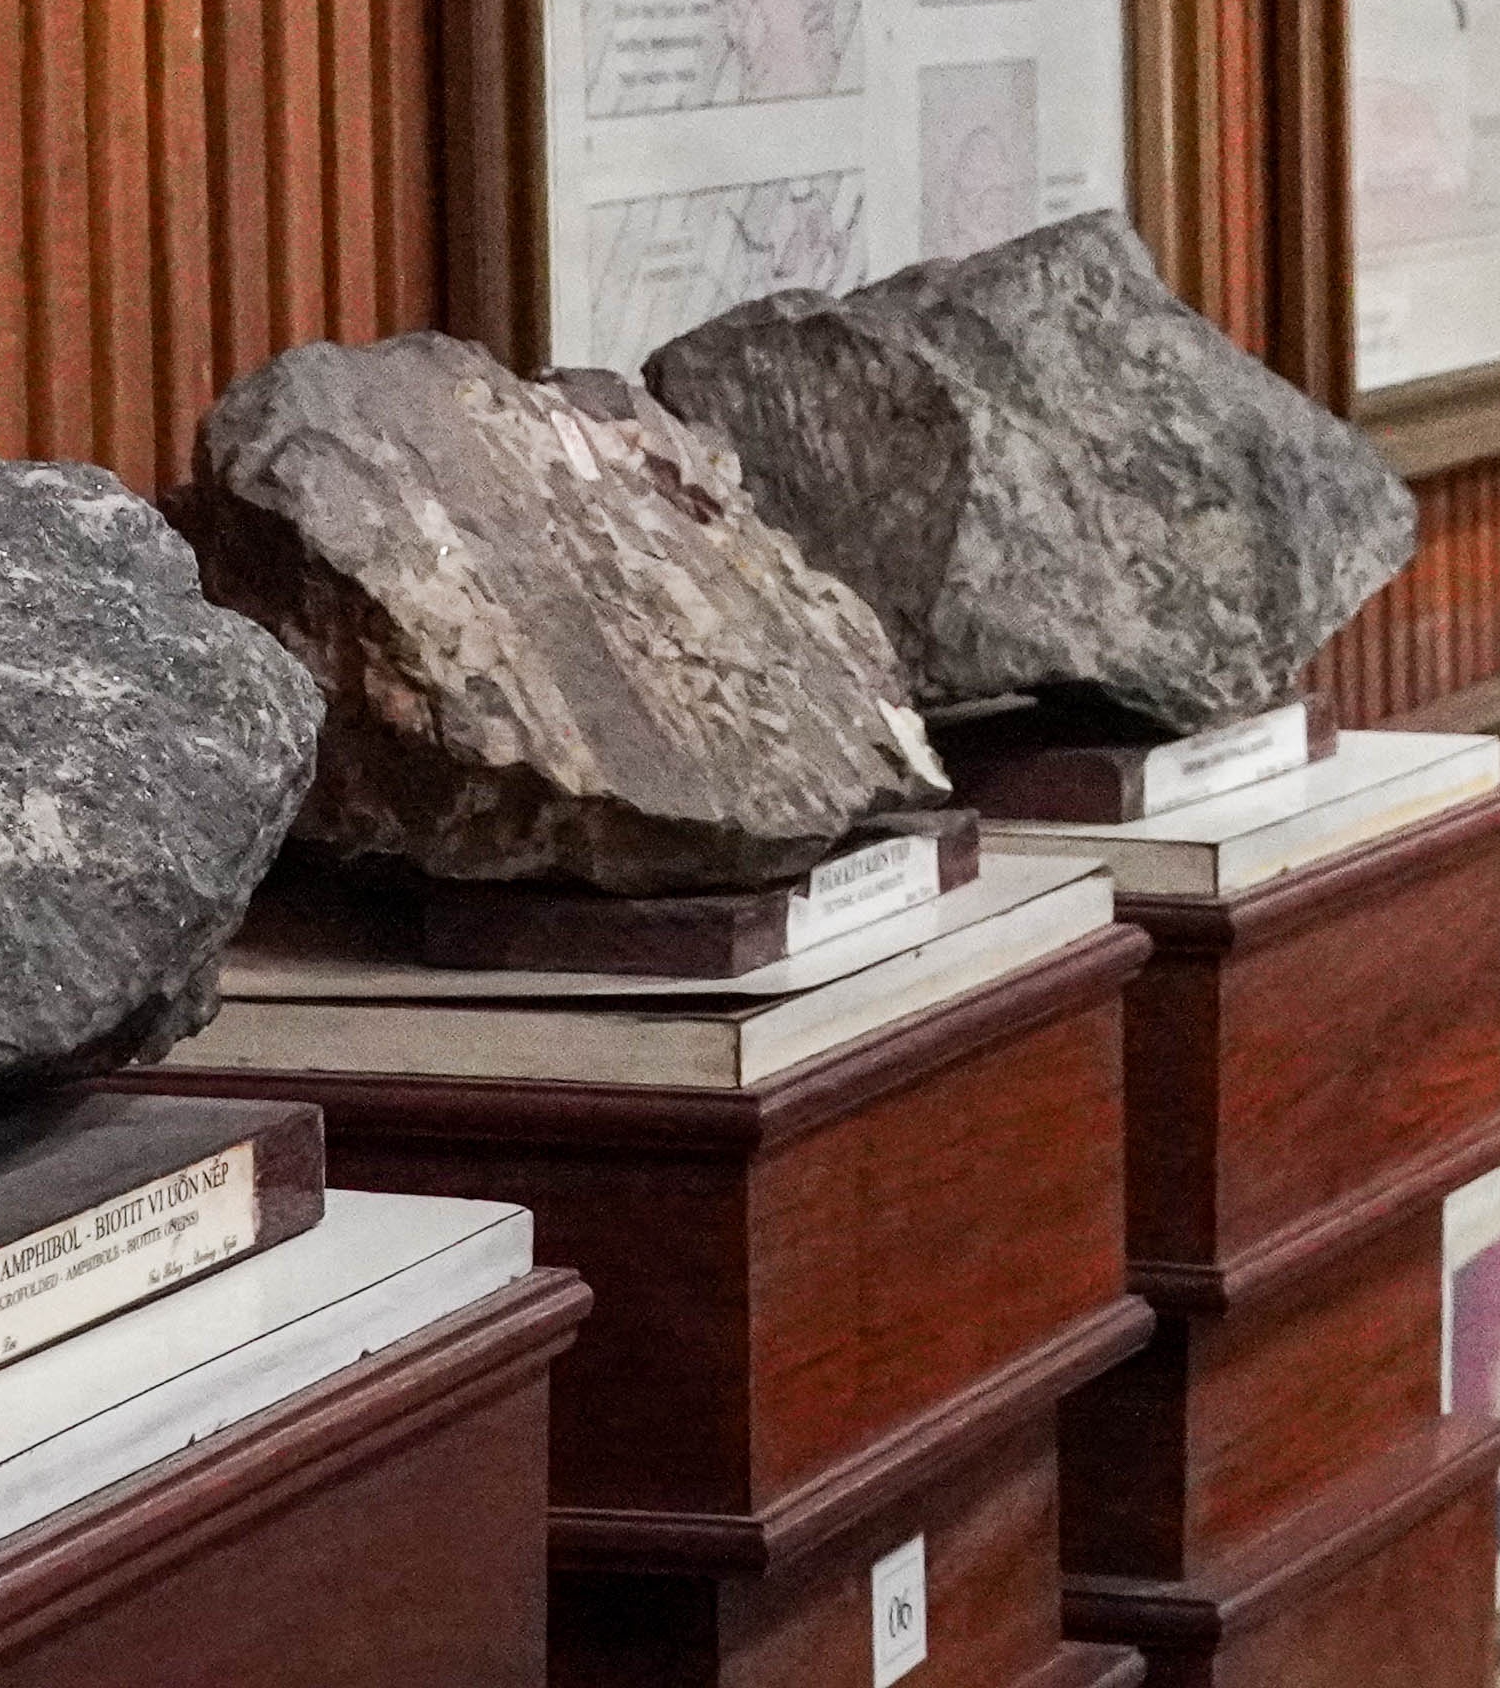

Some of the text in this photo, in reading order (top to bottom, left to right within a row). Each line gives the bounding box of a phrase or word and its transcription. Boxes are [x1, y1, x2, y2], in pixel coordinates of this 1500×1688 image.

[0, 1227, 82, 1282] AMPHIBOL
[95, 1198, 145, 1242] BIOTIT
[149, 1190, 164, 1215] VI
[64, 1245, 119, 1281] AMPHIBOLE
